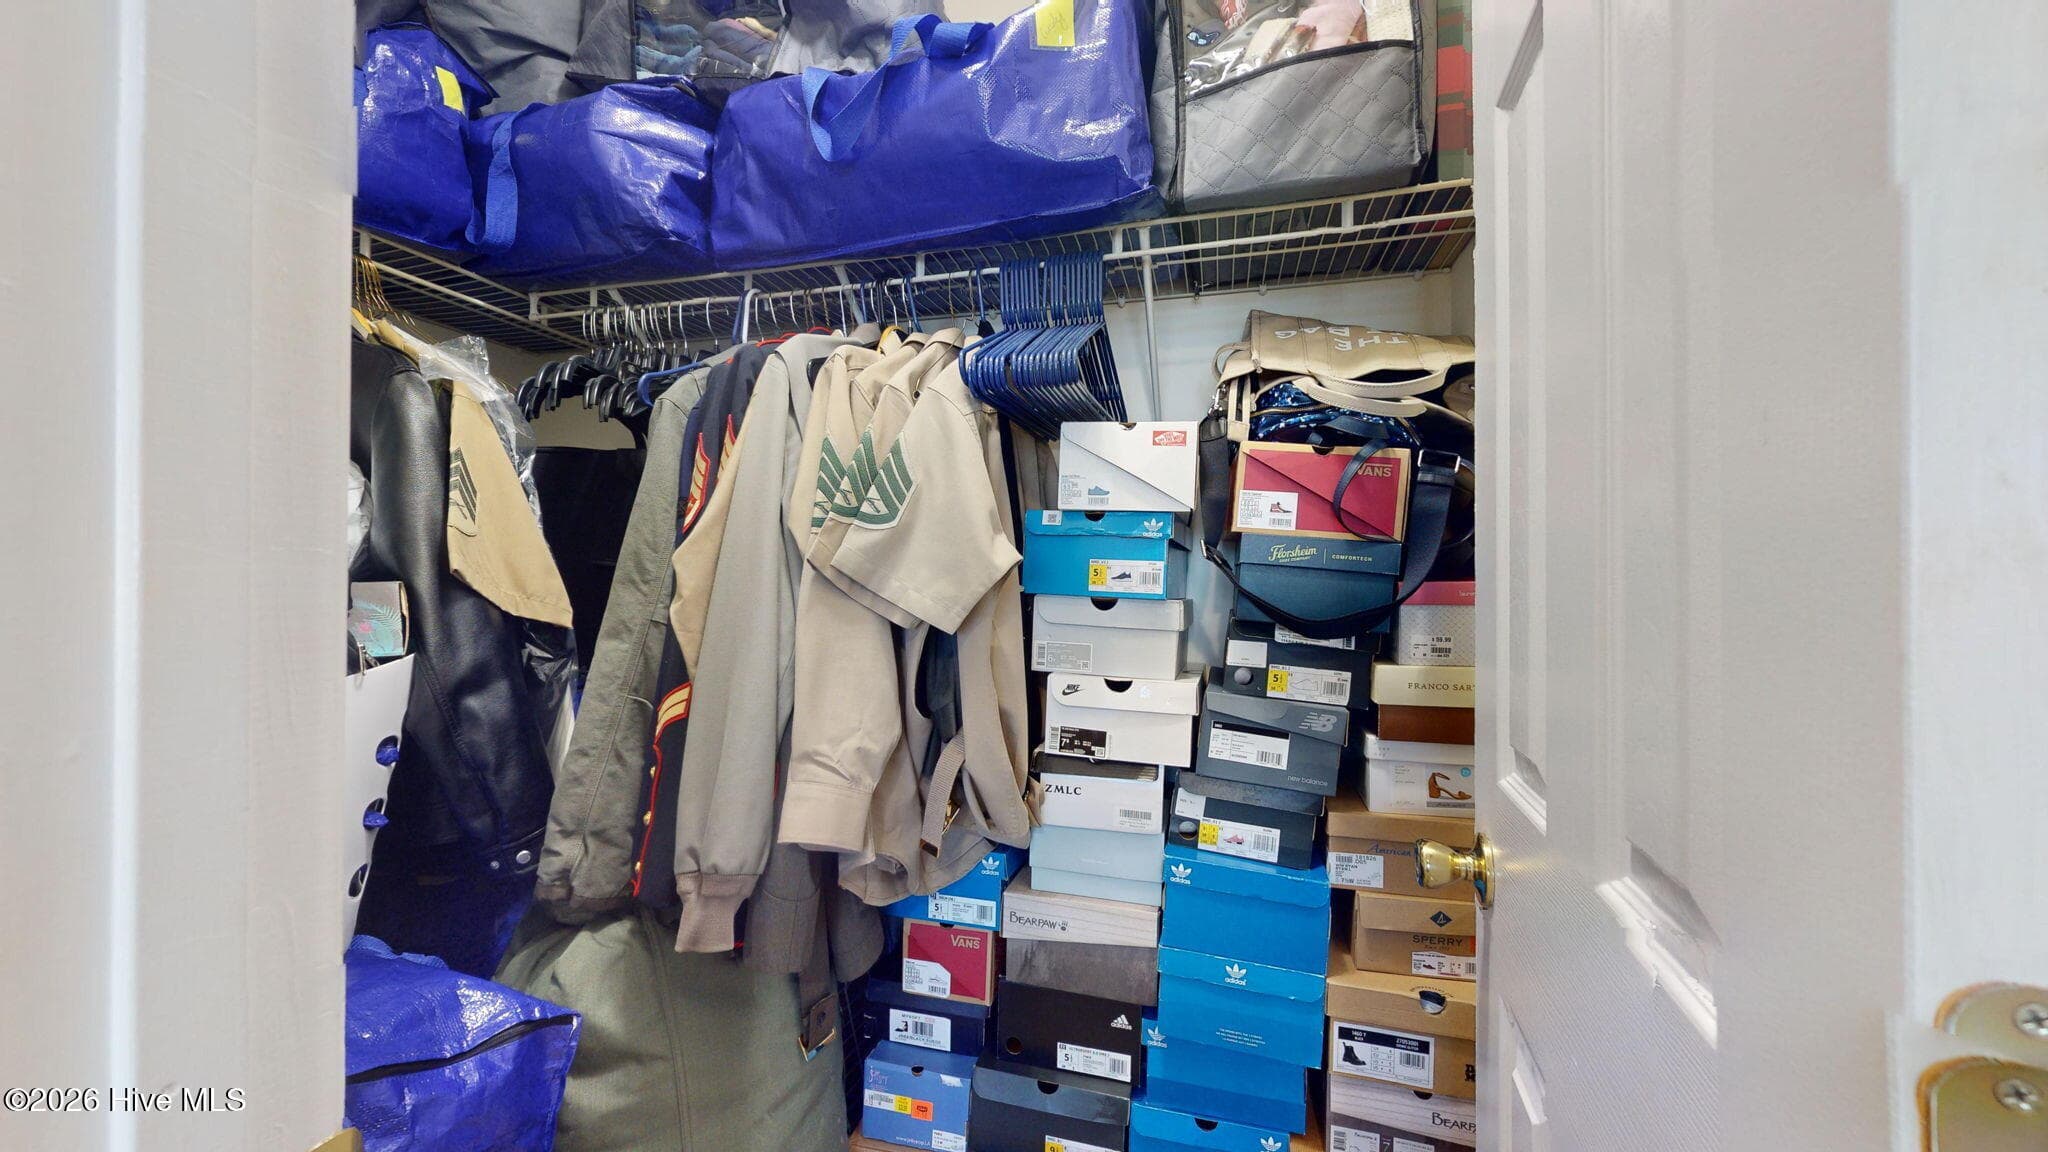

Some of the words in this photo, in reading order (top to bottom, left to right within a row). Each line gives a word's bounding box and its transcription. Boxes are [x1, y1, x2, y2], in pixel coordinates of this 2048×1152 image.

[1268, 543, 1318, 562] Florsheim
[1331, 554, 1373, 562] COMFORTECH
[1065, 683, 1081, 691] NIKE
[1408, 682, 1450, 691] FRANCO
[1452, 683, 1476, 692] SAR
[1287, 775, 1301, 783] new
[1301, 777, 1328, 787] balance
[1044, 783, 1082, 796] ZMLC
[1170, 876, 1191, 885] adidas
[1009, 910, 1057, 930] BEARPAW
[950, 934, 981, 950] VANS
[1412, 934, 1463, 947] SPERRY
[1224, 977, 1247, 986] adidas
[1110, 1021, 1133, 1031] adidas
